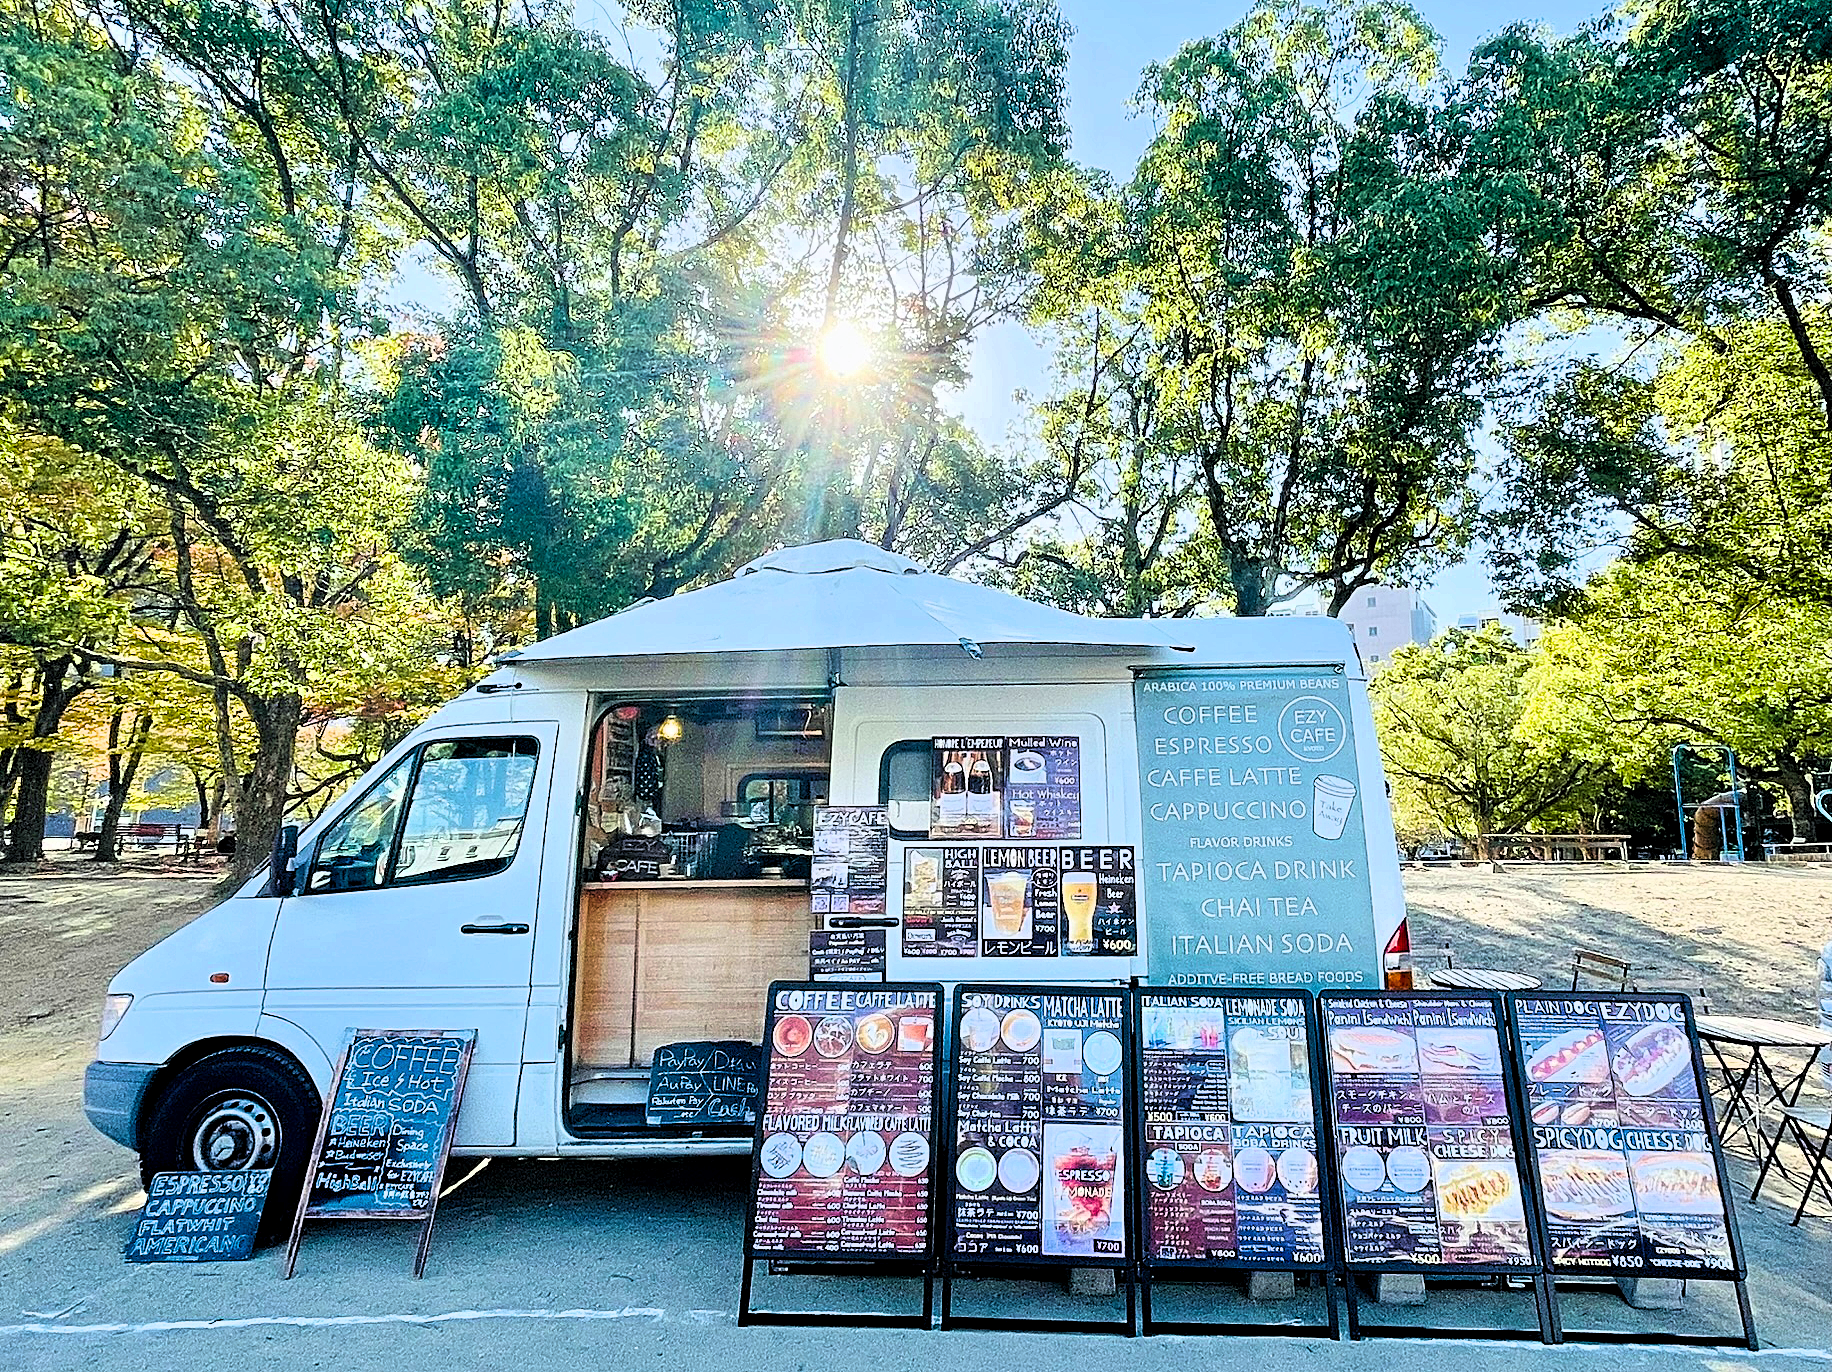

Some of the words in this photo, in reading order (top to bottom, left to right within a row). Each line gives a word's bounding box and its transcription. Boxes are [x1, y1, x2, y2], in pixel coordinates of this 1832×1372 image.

[1143, 682, 1196, 693] ARABICA
[1202, 680, 1235, 692] 100%
[1240, 680, 1295, 692] PREMIUM
[1299, 679, 1340, 690] BEANS
[1164, 705, 1257, 725] COFFEE
[1294, 709, 1327, 725] EZY
[1008, 738, 1046, 748] Mulled
[1048, 738, 1078, 748] Wine
[1290, 728, 1336, 743] CAFE
[1154, 735, 1272, 755] ESPRESSO
[1054, 776, 1076, 785] ¥600
[1147, 768, 1221, 787] CAFFE
[1229, 767, 1302, 786] LATTE
[1012, 789, 1034, 800] Hot
[1149, 800, 1307, 821] CAPPUCCINO
[1320, 800, 1342, 813] Take
[817, 811, 888, 826] EZYCAFE
[622, 838, 657, 851] EZY
[1190, 836, 1239, 849] FLAVOR
[1243, 836, 1293, 848] DRINKS
[944, 848, 977, 860] HIGH
[983, 848, 1026, 868] LEMON
[1028, 848, 1057, 868] BEER
[1061, 848, 1133, 870] BEER
[615, 859, 659, 874] CAFE
[945, 860, 978, 869] BALL
[1156, 861, 1267, 882] TAPIOCA
[1275, 859, 1357, 880] DRINK
[1098, 872, 1134, 884] Heineken
[1106, 888, 1124, 899] Beer
[1035, 908, 1056, 919] Beer
[1201, 898, 1261, 918] CHAI
[1267, 896, 1318, 917] TEA
[1106, 928, 1126, 936] ビール
[984, 940, 1057, 955] レモンビール
[1102, 938, 1132, 950] ¥600
[1171, 934, 1273, 956] ITALIAN
[1281, 932, 1354, 954] SODA
[1168, 973, 1265, 986] ADDITVE-FREE
[1269, 972, 1313, 984] BREAD
[1318, 971, 1364, 984] FOODS
[776, 990, 856, 1011] COFFEE
[856, 992, 892, 1008] CAFFE
[895, 992, 936, 1009] LATTE
[961, 992, 990, 1008] SOY
[994, 994, 1042, 1010] DRINKS
[1044, 996, 1088, 1018] MATCHA
[1091, 997, 1124, 1018] LATTE
[1141, 995, 1188, 1008] ITALIAN
[1189, 996, 1224, 1008] SODA
[1226, 998, 1278, 1016] LEMONADE
[1280, 998, 1306, 1017] SODA
[1514, 998, 1562, 1015] PLAIN
[1564, 1001, 1599, 1016] DOG
[1328, 1010, 1361, 1026] Panini
[1414, 1010, 1447, 1026] Panini
[1600, 1002, 1686, 1022] EZYDOG
[1266, 1018, 1306, 1026] LEMONS
[354, 1044, 461, 1074] COFFEE
[660, 1048, 704, 1070] PayPay
[1022, 1056, 1040, 1066] 700
[362, 1072, 390, 1087] Ice
[408, 1074, 444, 1092] Hot
[656, 1076, 702, 1092] AuPay
[714, 1076, 745, 1092] LINE
[1023, 1092, 1040, 1102] 700
[1046, 1086, 1090, 1094] Matcha
[1091, 1086, 1122, 1095] Latte
[1337, 1090, 1416, 1100] スモークチキンと
[344, 1092, 385, 1109] Italian
[388, 1098, 440, 1116] SODA
[708, 1098, 752, 1118] Cash
[1022, 1110, 1040, 1120] 700
[1096, 1108, 1118, 1117] ¥700
[1147, 1111, 1172, 1122] ¥500
[330, 1114, 388, 1137] BEER
[762, 1114, 820, 1132] FLAVORED
[822, 1114, 847, 1132] MILK
[958, 1118, 1002, 1133] Matcha
[1004, 1120, 1038, 1133] Latte
[392, 1124, 424, 1140] Dining
[1153, 1126, 1225, 1141] TAPIOCA
[1232, 1126, 1315, 1139] TAPIOCA
[1340, 1128, 1383, 1146] FRUIT
[1388, 1128, 1428, 1146] MILK
[1442, 1129, 1500, 1144] SPICY
[1533, 1128, 1624, 1150] SPICYDOG
[396, 1140, 428, 1152] Space
[988, 1135, 996, 1148] &
[998, 1135, 1038, 1148] COCOA
[1234, 1138, 1267, 1148] BOBA
[1272, 1138, 1316, 1148] DRINKS
[1626, 1130, 1684, 1150] CHEESE
[1686, 1132, 1712, 1152] DOG
[1434, 1144, 1487, 1158] CHEESE
[1491, 1146, 1516, 1158] DOG
[316, 1172, 378, 1192] HighBall
[1057, 1168, 1111, 1182] ESPRESSO
[152, 1174, 244, 1196] ESPRESSO
[146, 1198, 256, 1217] CAPPUCCINO
[1016, 1210, 1039, 1220] ¥700
[138, 1216, 236, 1236] FLATWHIT
[130, 1234, 249, 1256] AMERICANO
[1016, 1244, 1039, 1254] ¥600
[1096, 1242, 1120, 1251] ¥700
[1551, 1237, 1638, 1250] スパイシードッグ
[1292, 1251, 1321, 1262] ¥600
[1408, 1252, 1440, 1264] ¥500
[1506, 1256, 1532, 1266] ¥950
[1612, 1254, 1644, 1268] ¥850
[1703, 1257, 1734, 1271] ¥900
